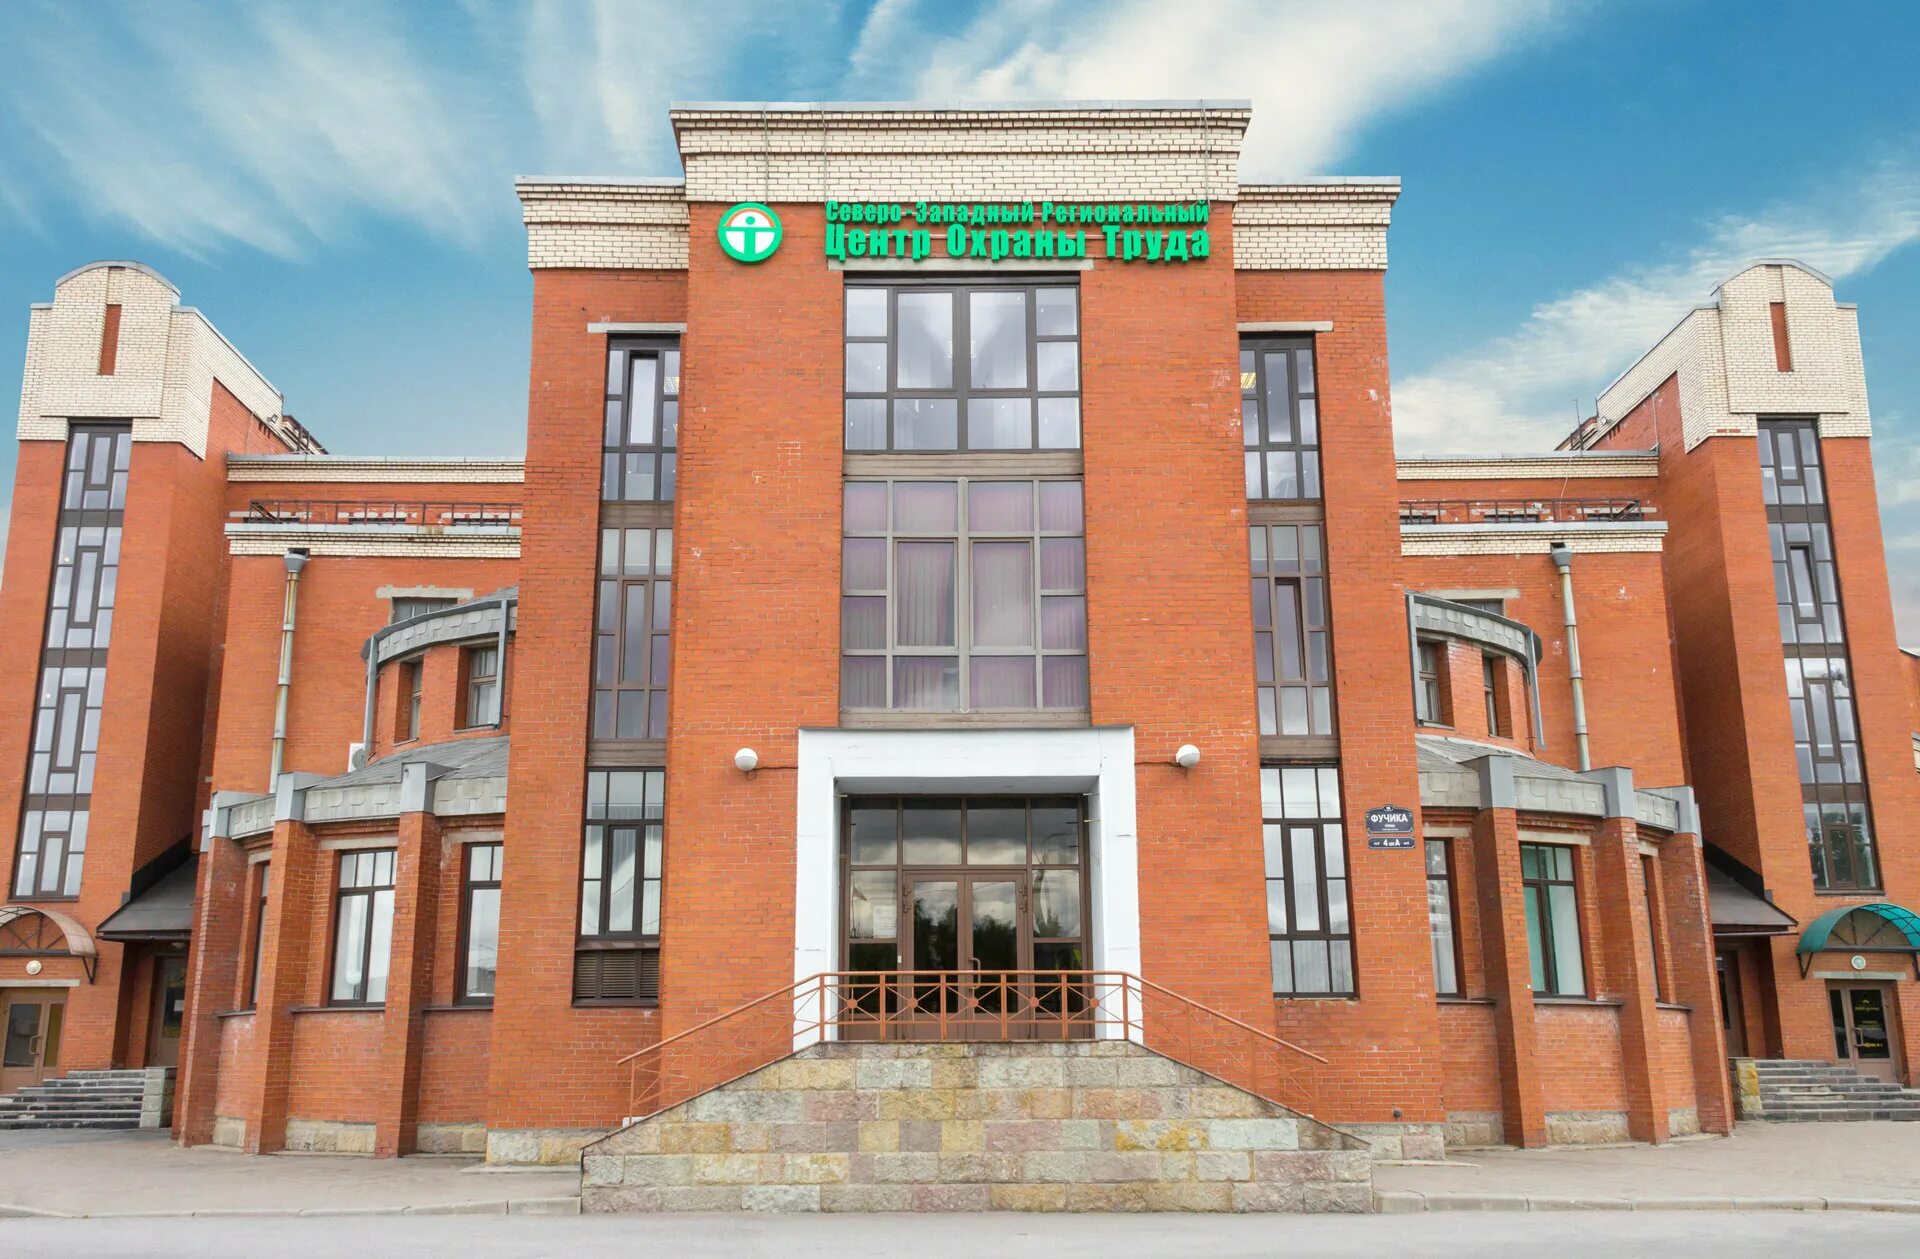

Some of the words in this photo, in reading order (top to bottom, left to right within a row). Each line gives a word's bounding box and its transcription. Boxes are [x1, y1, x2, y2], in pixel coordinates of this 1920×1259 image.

[1042, 199, 1209, 224] Региональный
[826, 223, 931, 262] Центр
[947, 224, 1086, 261] Охраны
[1102, 225, 1210, 263] Труда
[1370, 814, 1408, 822] ФУЧИКА
